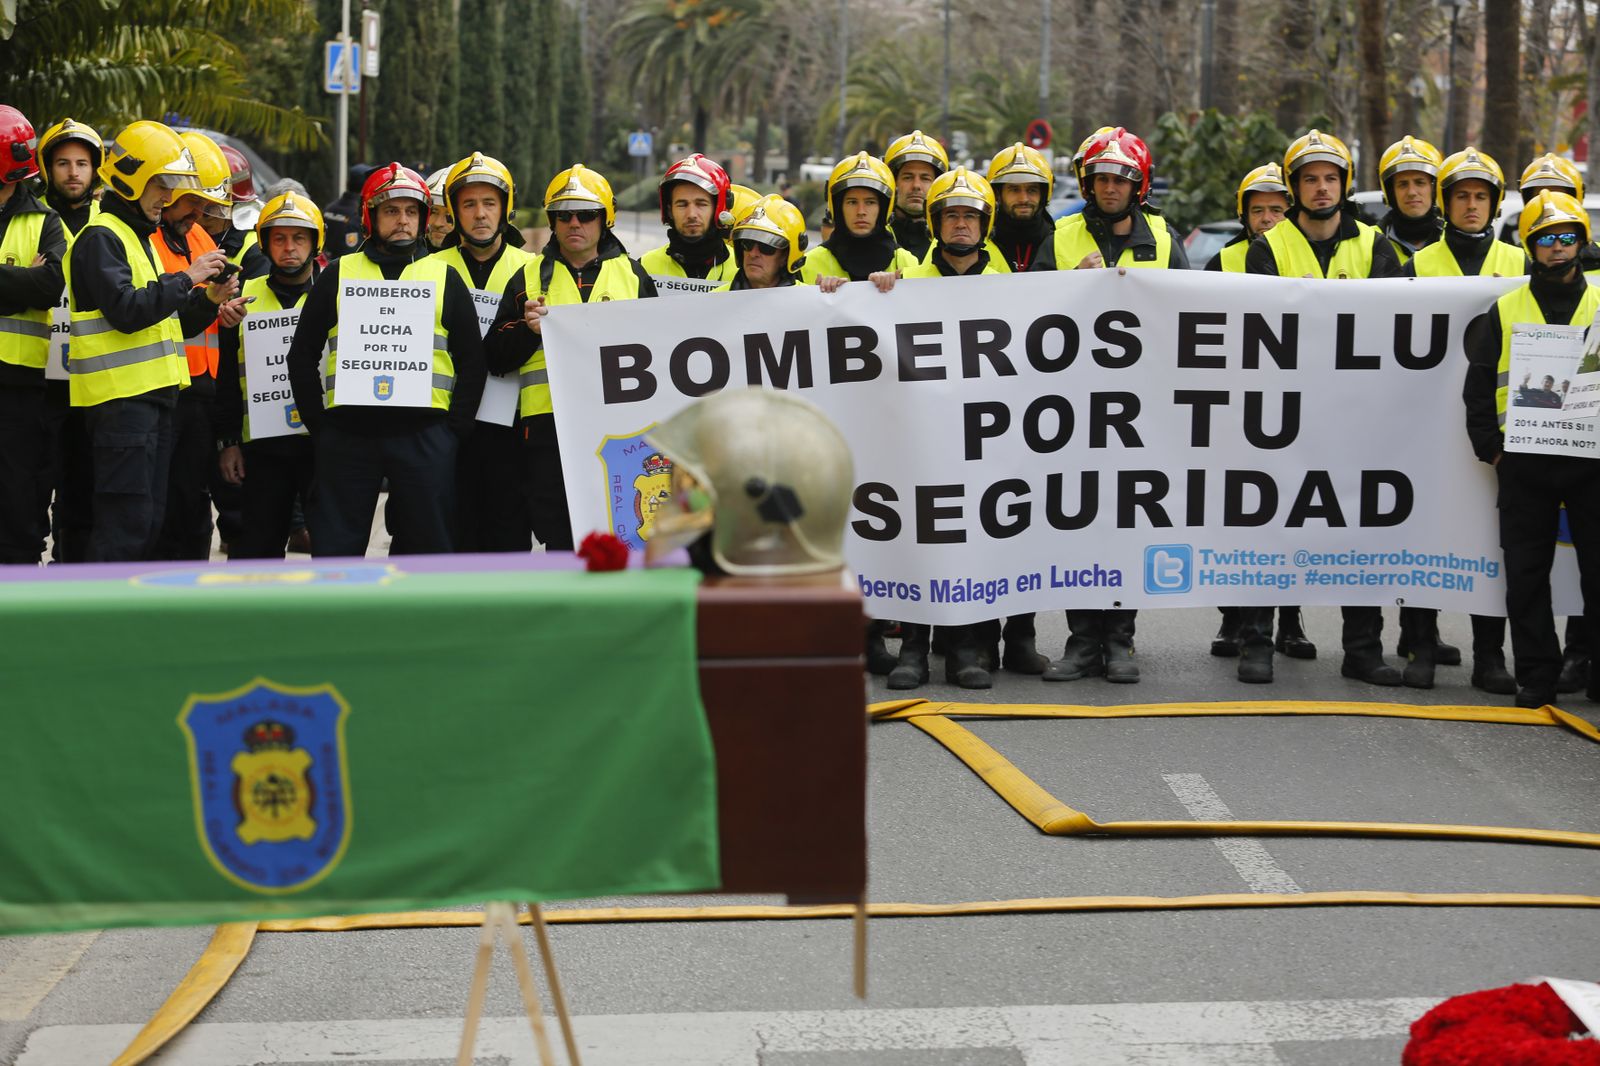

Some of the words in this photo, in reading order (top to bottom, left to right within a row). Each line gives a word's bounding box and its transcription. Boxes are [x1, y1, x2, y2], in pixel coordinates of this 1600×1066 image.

[345, 286, 431, 299] BOMBEROS
[379, 307, 395, 315] EN
[247, 315, 299, 331] BOMBE
[360, 324, 413, 336] LUCHA
[364, 344, 388, 352] POR
[391, 344, 407, 353] TU
[265, 354, 286, 367] LU
[599, 310, 1142, 404] BOMBEROS
[1176, 312, 1299, 370] EN
[341, 359, 428, 371] SEGURIDAD
[272, 373, 289, 383] PO
[963, 391, 1144, 461] POR
[1173, 390, 1301, 450] TU
[1514, 419, 1538, 427] 2014
[1541, 420, 1573, 430] ANTES
[1576, 423, 1585, 431] SI
[1509, 435, 1532, 444] 2017
[1535, 437, 1569, 447] AHORA
[1572, 440, 1597, 449] NO??
[613, 474, 624, 513] REAL
[851, 469, 1414, 544] SEGURIDAD
[1199, 549, 1286, 566] Twitter:
[1293, 549, 1500, 578] @encierrobombmlg
[930, 578, 1009, 605] Málaga
[1016, 572, 1042, 593] en
[1050, 564, 1122, 588] Lucha
[1199, 569, 1297, 590] Hashtag:
[1304, 570, 1474, 593] #encierroRCBM
